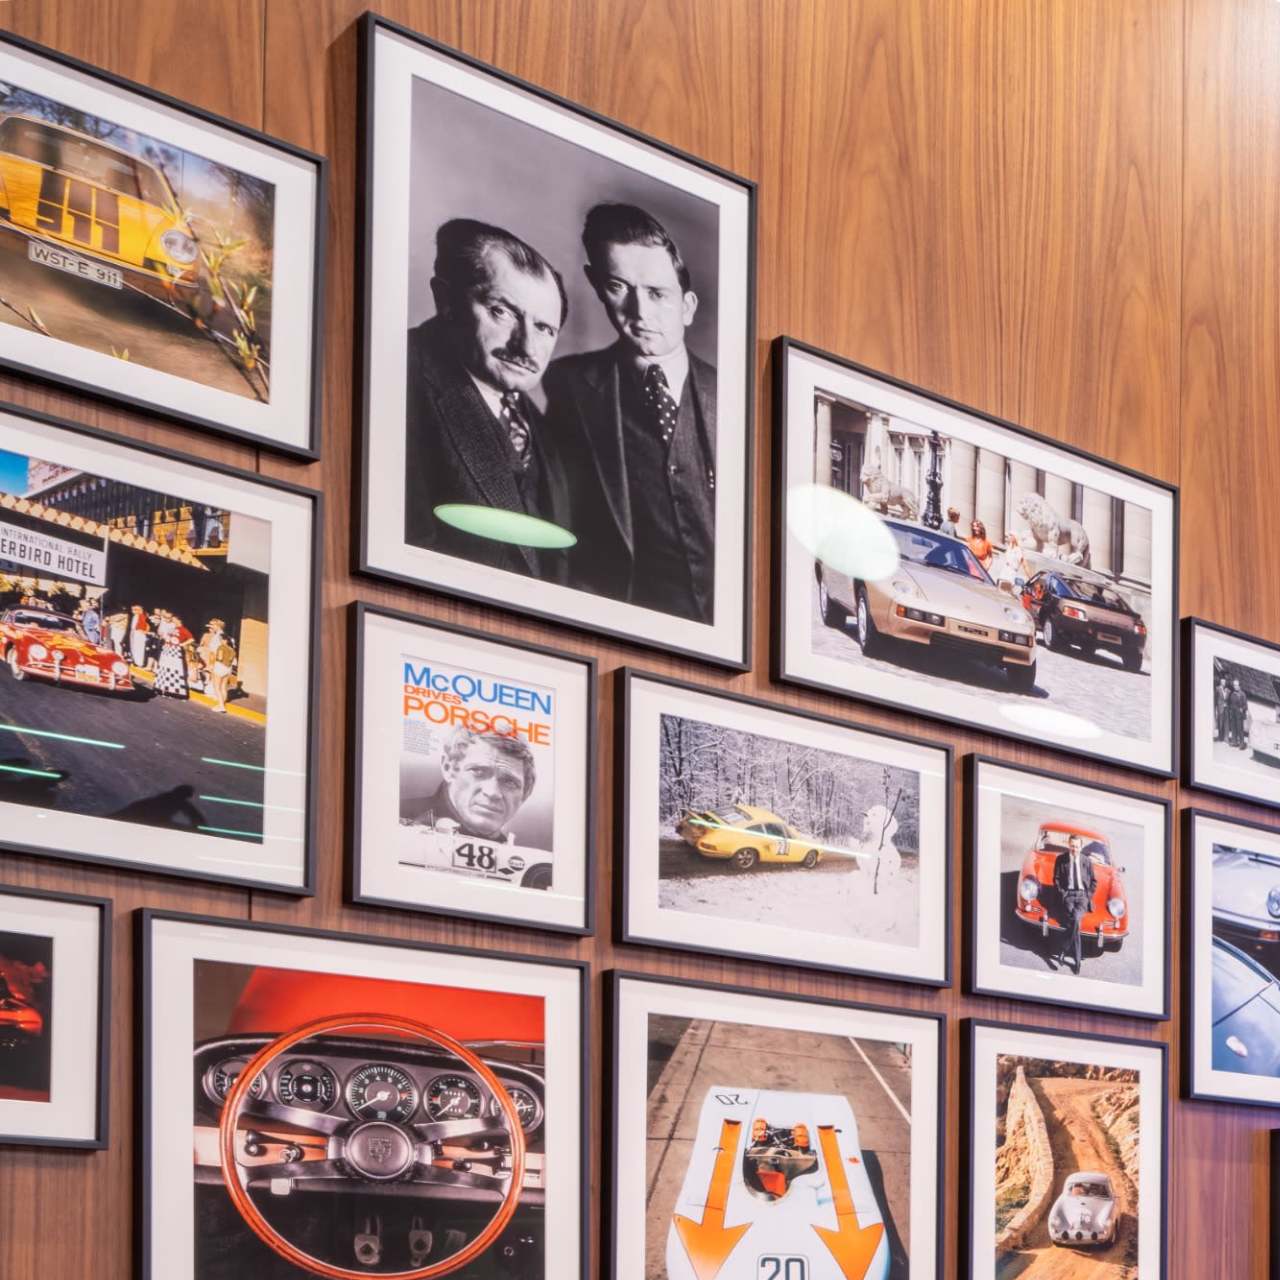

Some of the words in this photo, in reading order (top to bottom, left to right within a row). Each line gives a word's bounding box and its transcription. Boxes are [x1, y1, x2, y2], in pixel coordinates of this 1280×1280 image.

[36, 168, 120, 254] 911
[96, 267, 118, 285] 911
[0, 537, 52, 566] ERBIRD
[57, 553, 97, 579] HOTEL
[403, 662, 552, 716] McQUEEN
[403, 684, 462, 706] DRIVES
[403, 694, 552, 747] PORSCHE
[455, 842, 496, 870] 48
